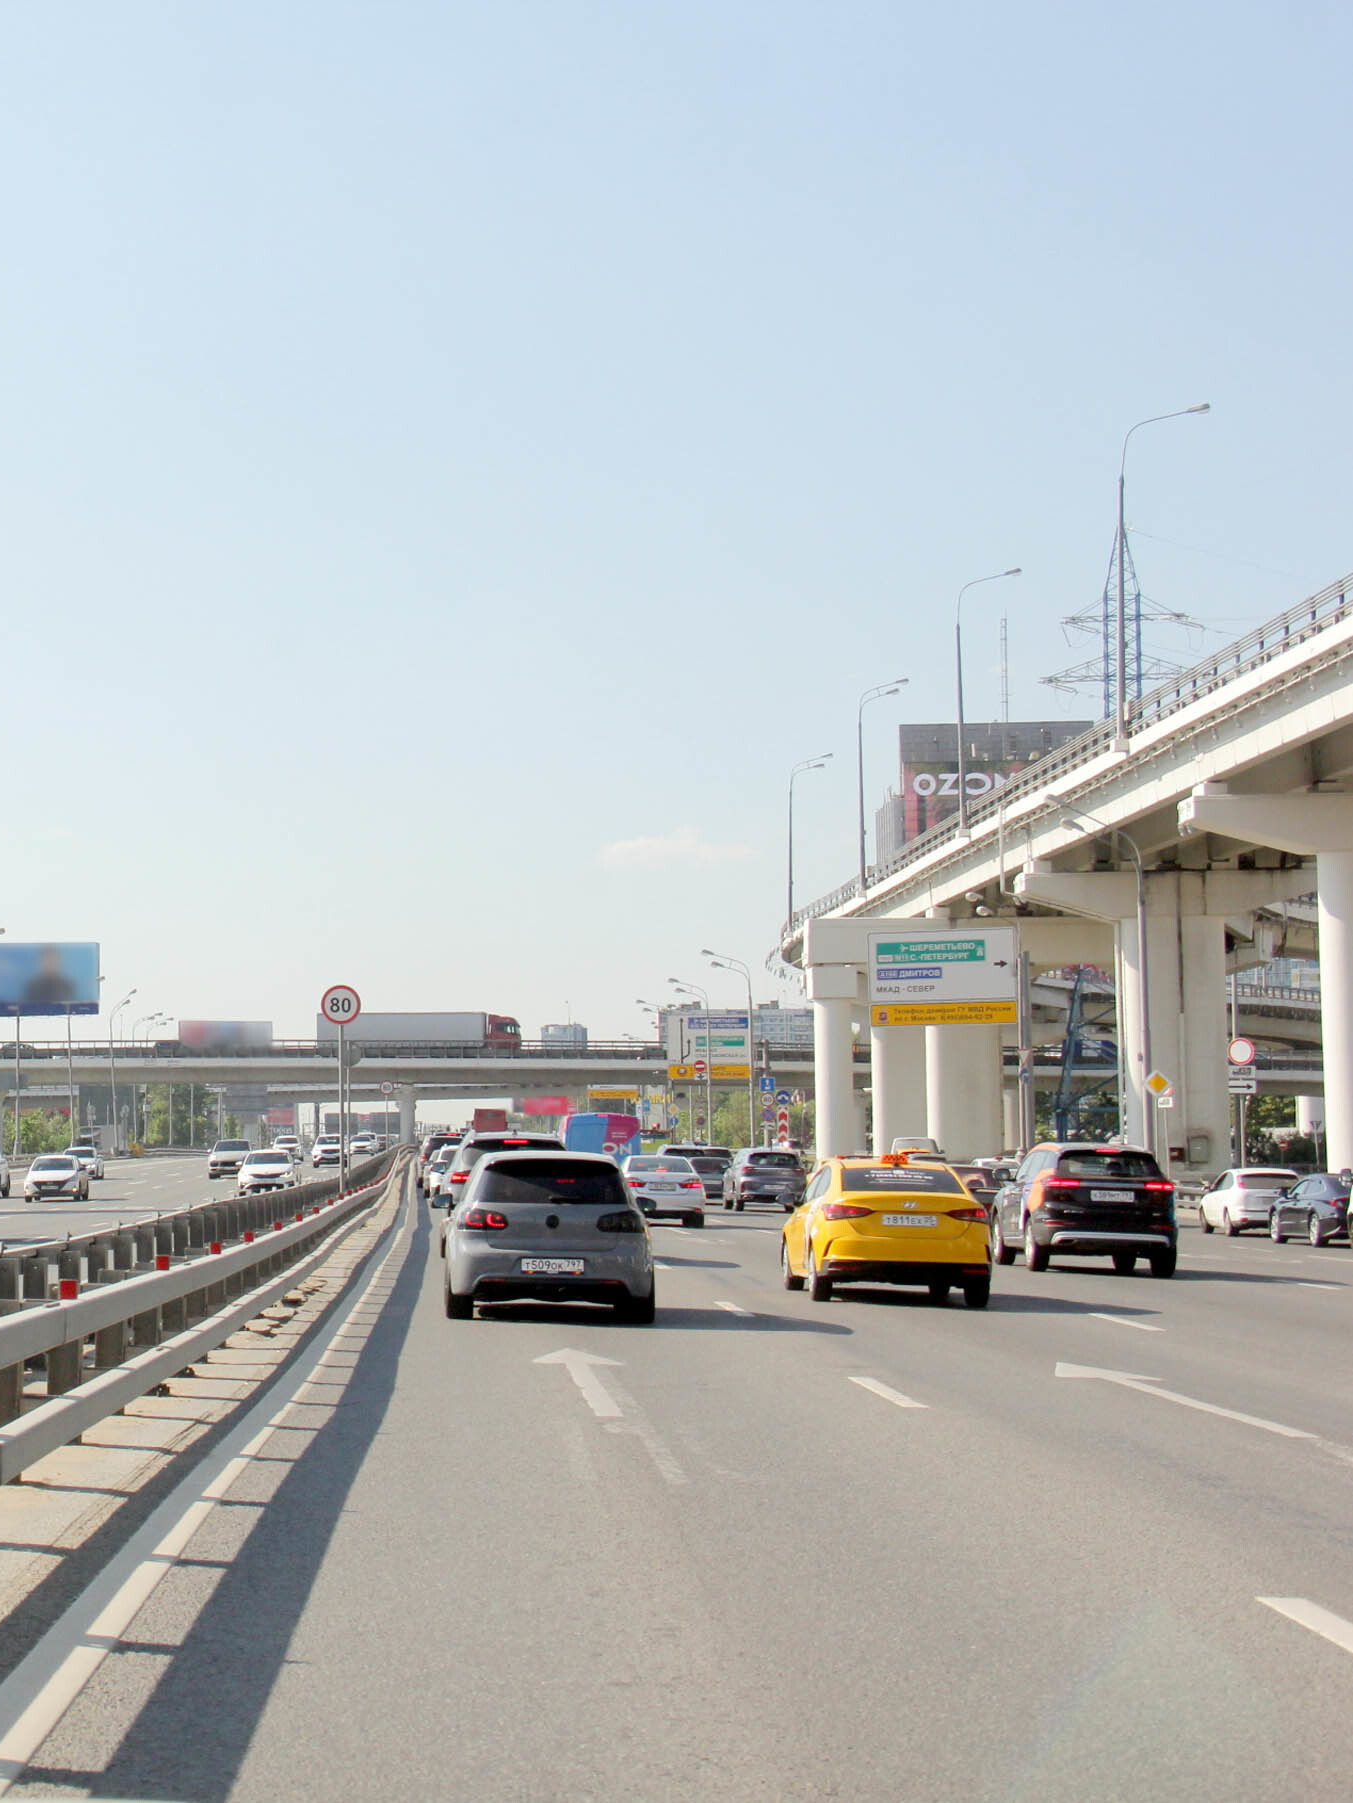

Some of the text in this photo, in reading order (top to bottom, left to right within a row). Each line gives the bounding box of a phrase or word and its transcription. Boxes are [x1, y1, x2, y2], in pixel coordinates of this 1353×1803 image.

[909, 941, 976, 952] ШЕРЕМЕТЬЕВО
[899, 969, 941, 978] ДМИТРОВ
[907, 985, 935, 993] СЕВЕР
[330, 997, 351, 1013] 80
[567, 1260, 581, 1268] 797
